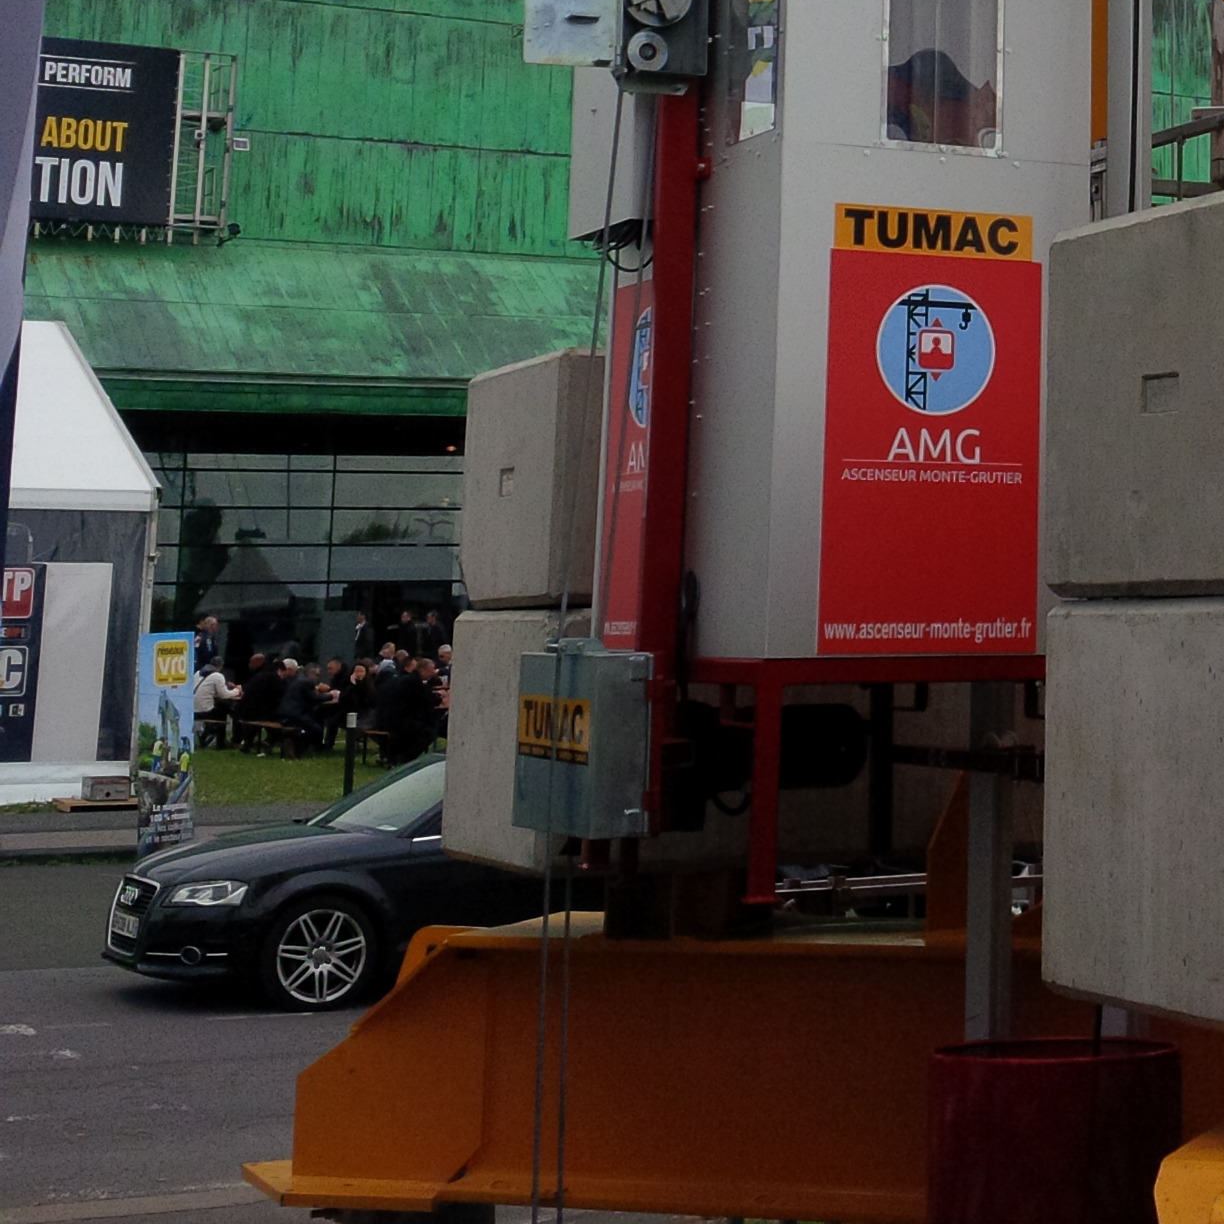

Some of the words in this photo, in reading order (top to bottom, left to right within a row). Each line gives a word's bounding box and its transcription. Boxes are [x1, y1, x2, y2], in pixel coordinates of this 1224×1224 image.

[44, 61, 132, 88] PERFORM
[40, 116, 129, 152] ABOUT
[844, 208, 1019, 256] TUMAC
[886, 427, 981, 464] AMG
[841, 467, 917, 482] ASCENSEUR
[919, 470, 1023, 484] MONTE-GRUTIER
[824, 618, 1031, 644] www.ascenseur-monte-grutier.fr
